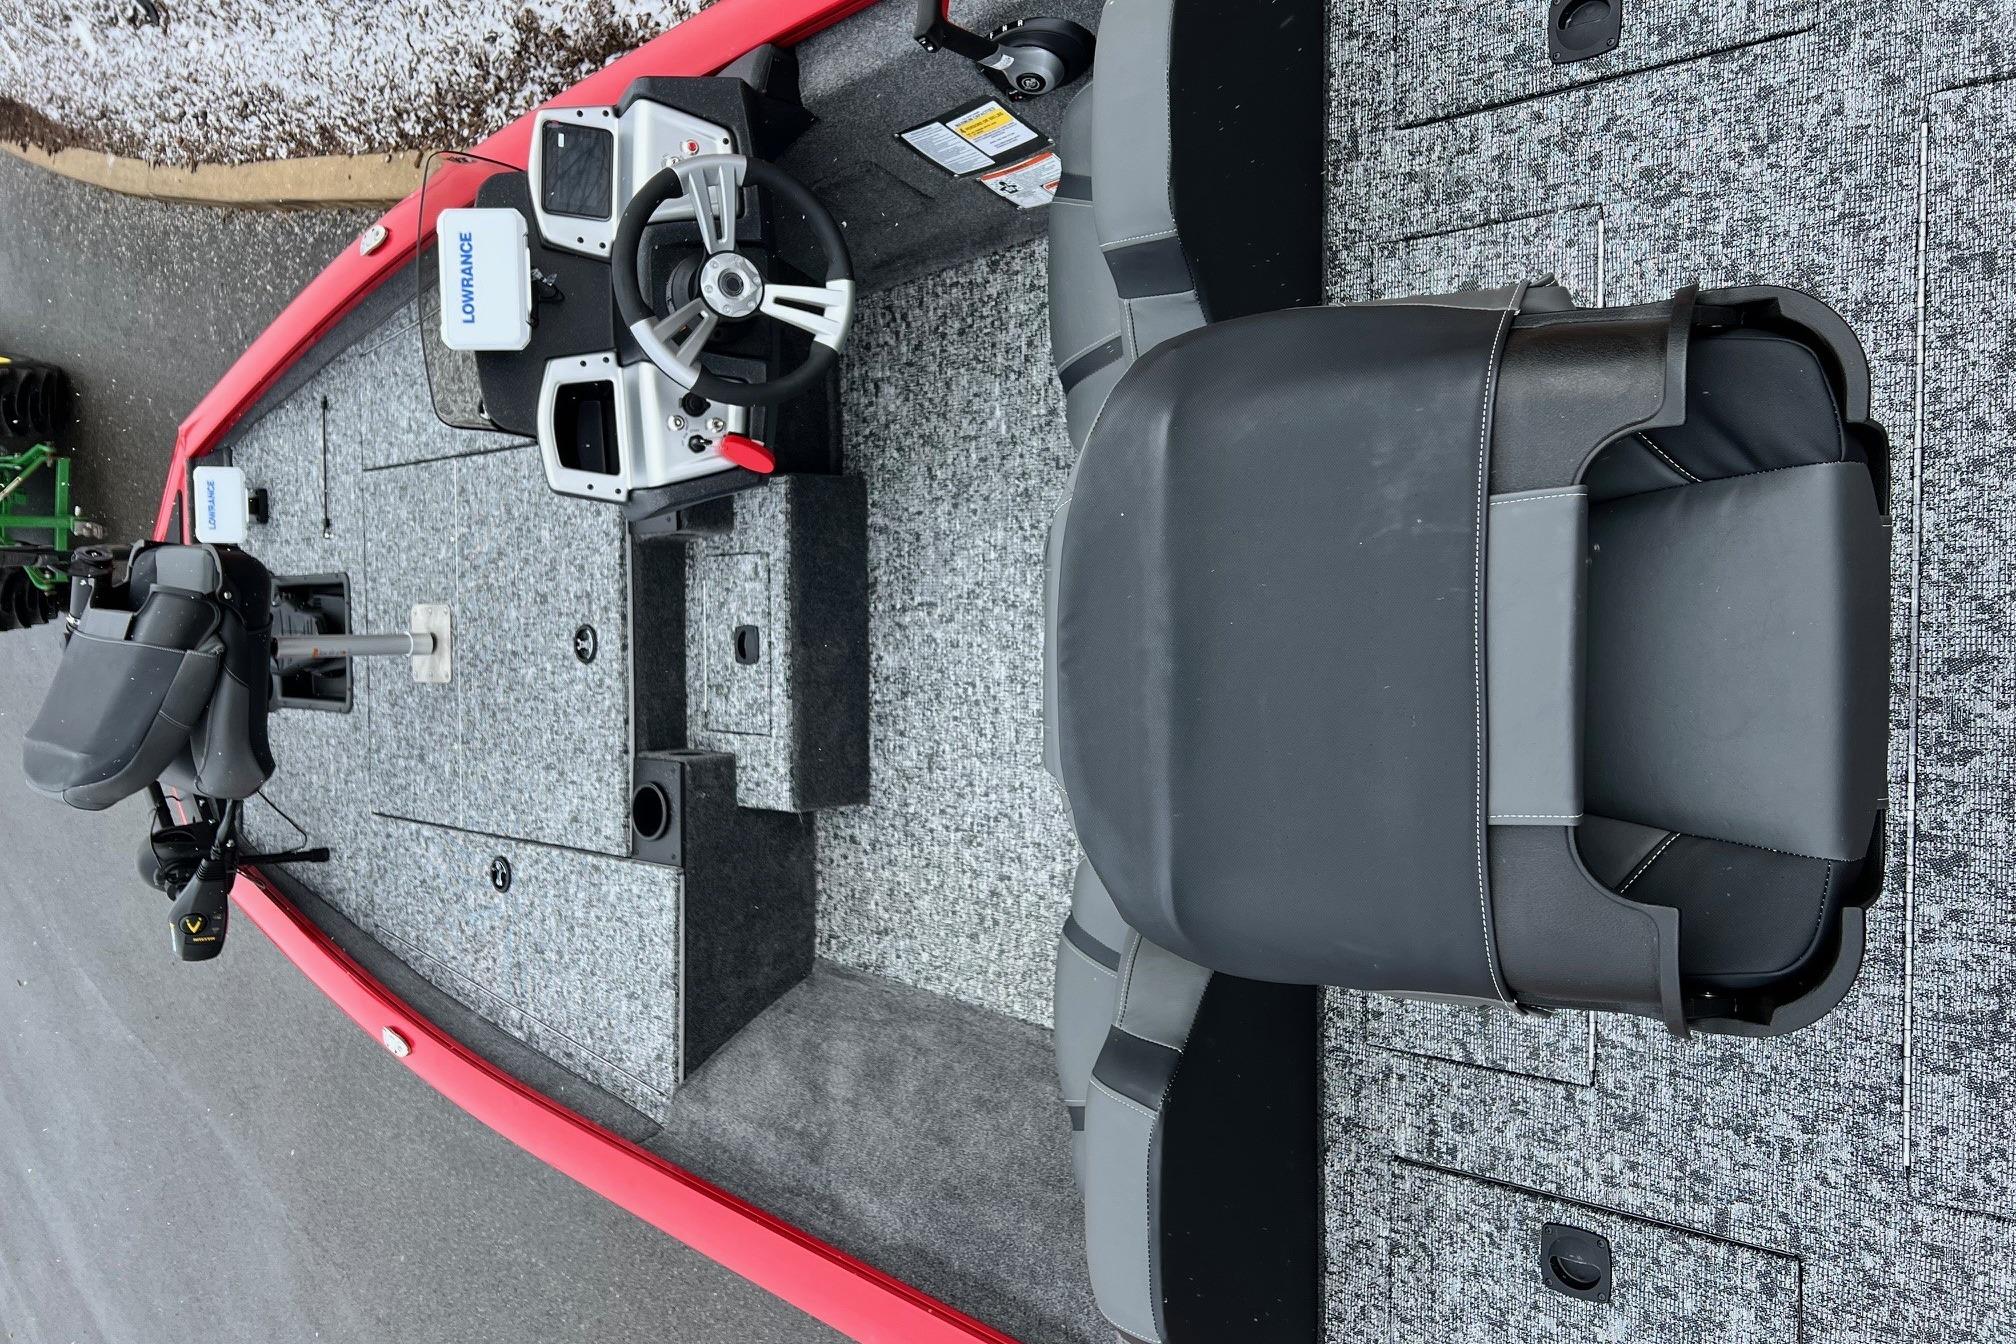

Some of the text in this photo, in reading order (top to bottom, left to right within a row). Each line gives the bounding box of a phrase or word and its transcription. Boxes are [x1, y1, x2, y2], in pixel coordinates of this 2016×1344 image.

[1017, 19, 1023, 27] R
[1002, 24, 1008, 32] N
[460, 232, 475, 323] LOWRANCE
